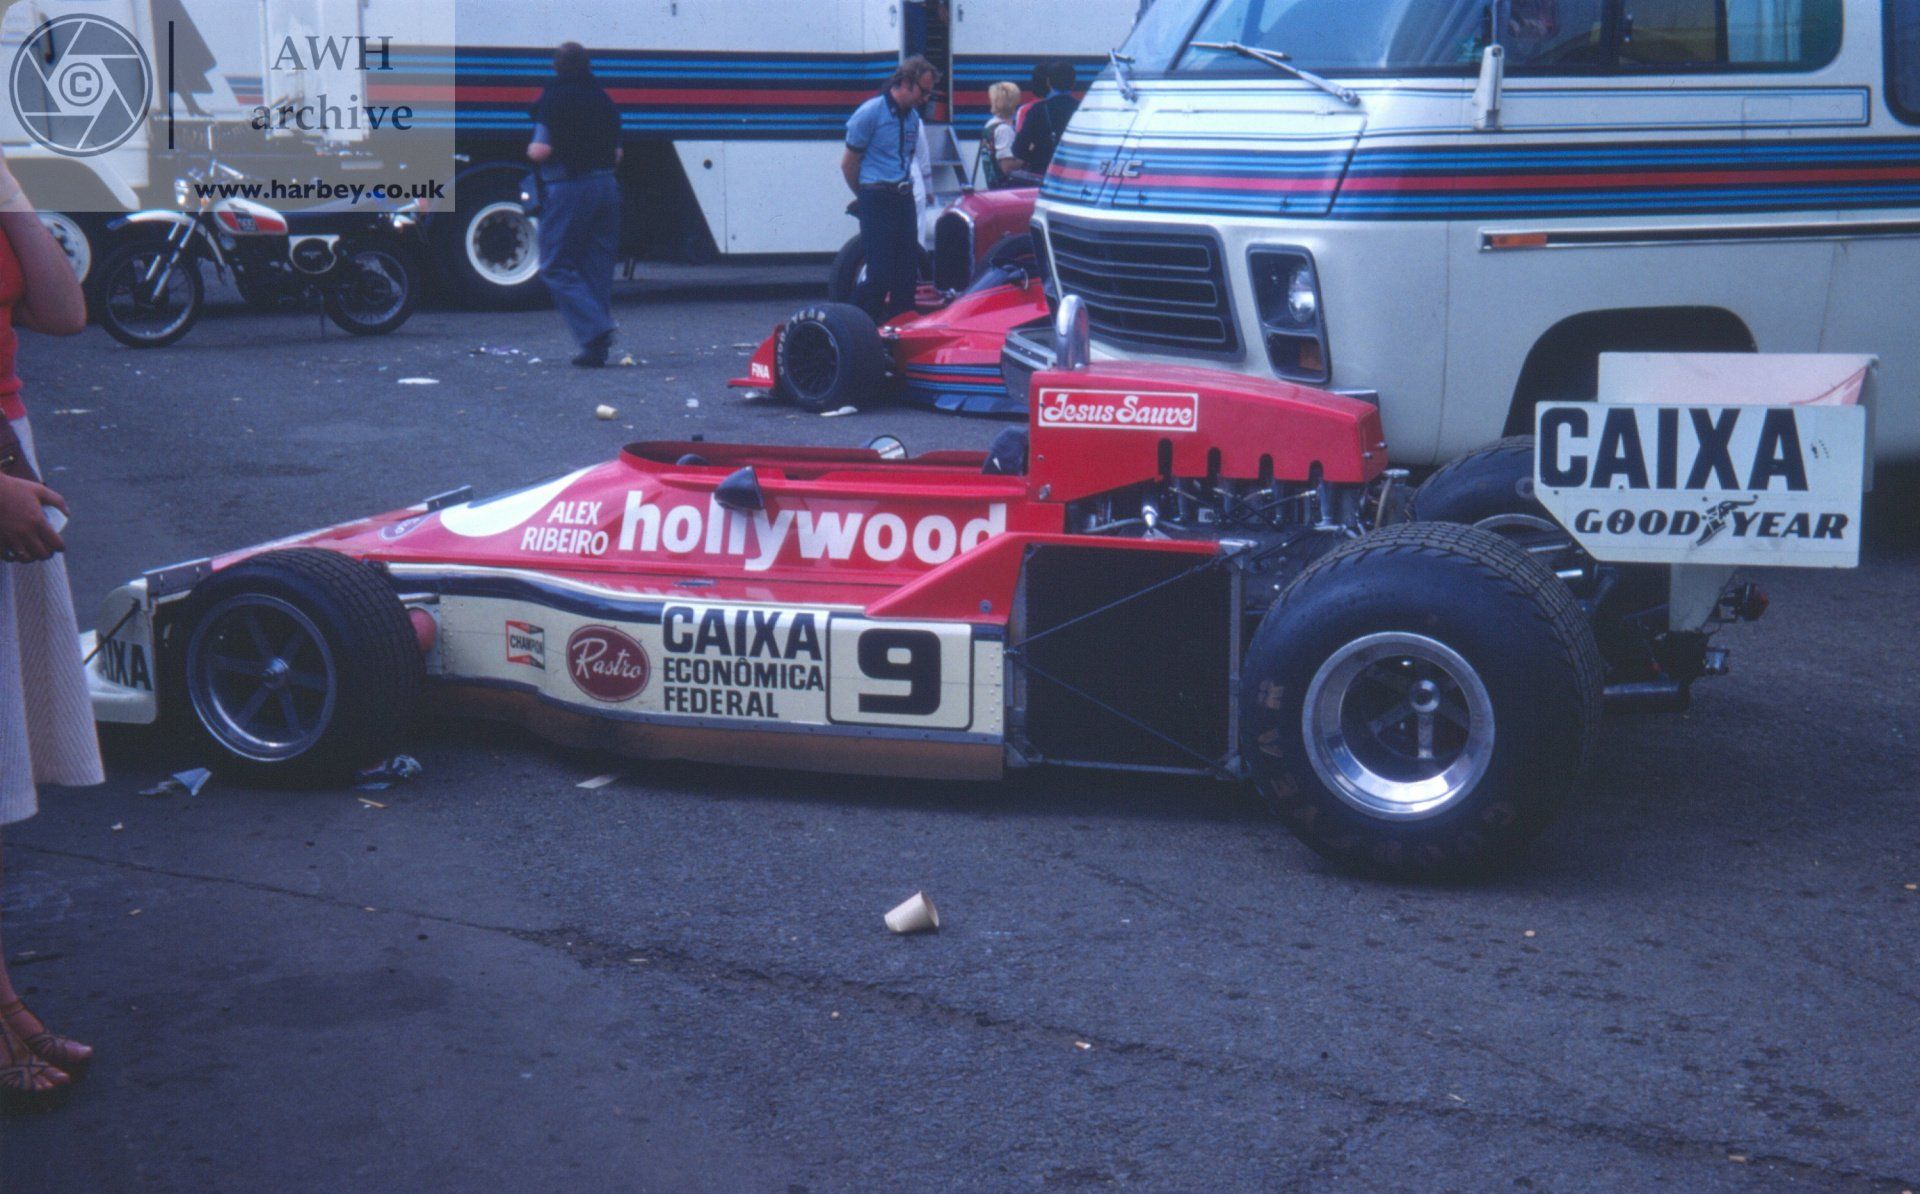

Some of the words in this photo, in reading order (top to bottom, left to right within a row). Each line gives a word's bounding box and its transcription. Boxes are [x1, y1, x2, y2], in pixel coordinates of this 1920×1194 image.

[751, 362, 770, 379] FINA
[1043, 393, 1115, 422] Jesus
[1115, 395, 1193, 425] Sauve
[1540, 407, 1809, 492] CAIXA
[547, 501, 602, 525] ALEX
[618, 490, 1007, 571] hollywood
[1574, 508, 1700, 536] GOOD
[1732, 511, 1849, 540] YEAR
[520, 527, 609, 555] RIBEIRO
[662, 605, 824, 661] CAIXA
[572, 637, 642, 679] Rastro
[663, 656, 825, 692] ECONÔMICA
[857, 627, 942, 716] 9
[663, 685, 779, 719] FEDERAL
